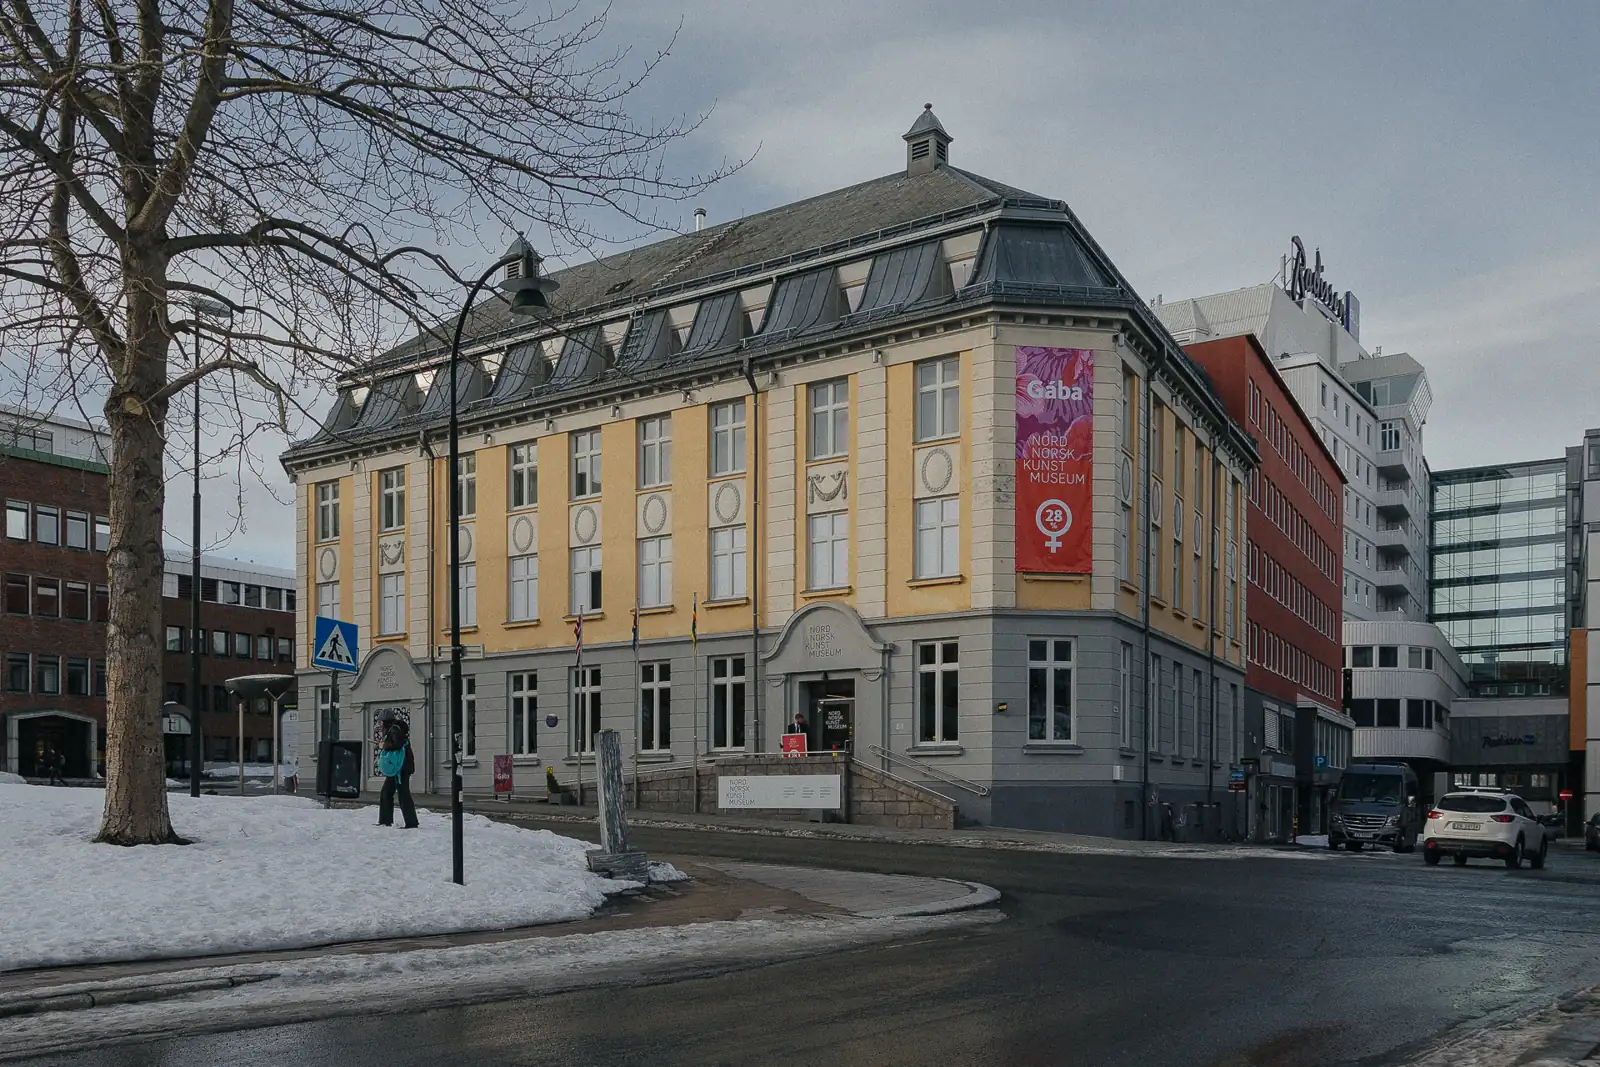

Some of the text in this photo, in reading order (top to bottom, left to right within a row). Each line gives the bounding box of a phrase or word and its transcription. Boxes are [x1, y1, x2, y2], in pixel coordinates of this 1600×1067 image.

[1027, 379, 1083, 401] Gába
[1031, 435, 1068, 447] NORD
[1031, 447, 1075, 460] NORSK
[1023, 459, 1066, 471] KUNST
[1030, 472, 1085, 485] MUSEUM
[1045, 509, 1063, 522] 28
[810, 624, 831, 633] NORD
[810, 632, 835, 641] NORSK
[805, 641, 830, 650] KUNST
[808, 648, 842, 658] MUSEUM
[729, 778, 747, 786] NORD
[729, 785, 751, 793] NORSK
[725, 792, 745, 800] KUNST
[728, 799, 756, 807] MUSEUM
